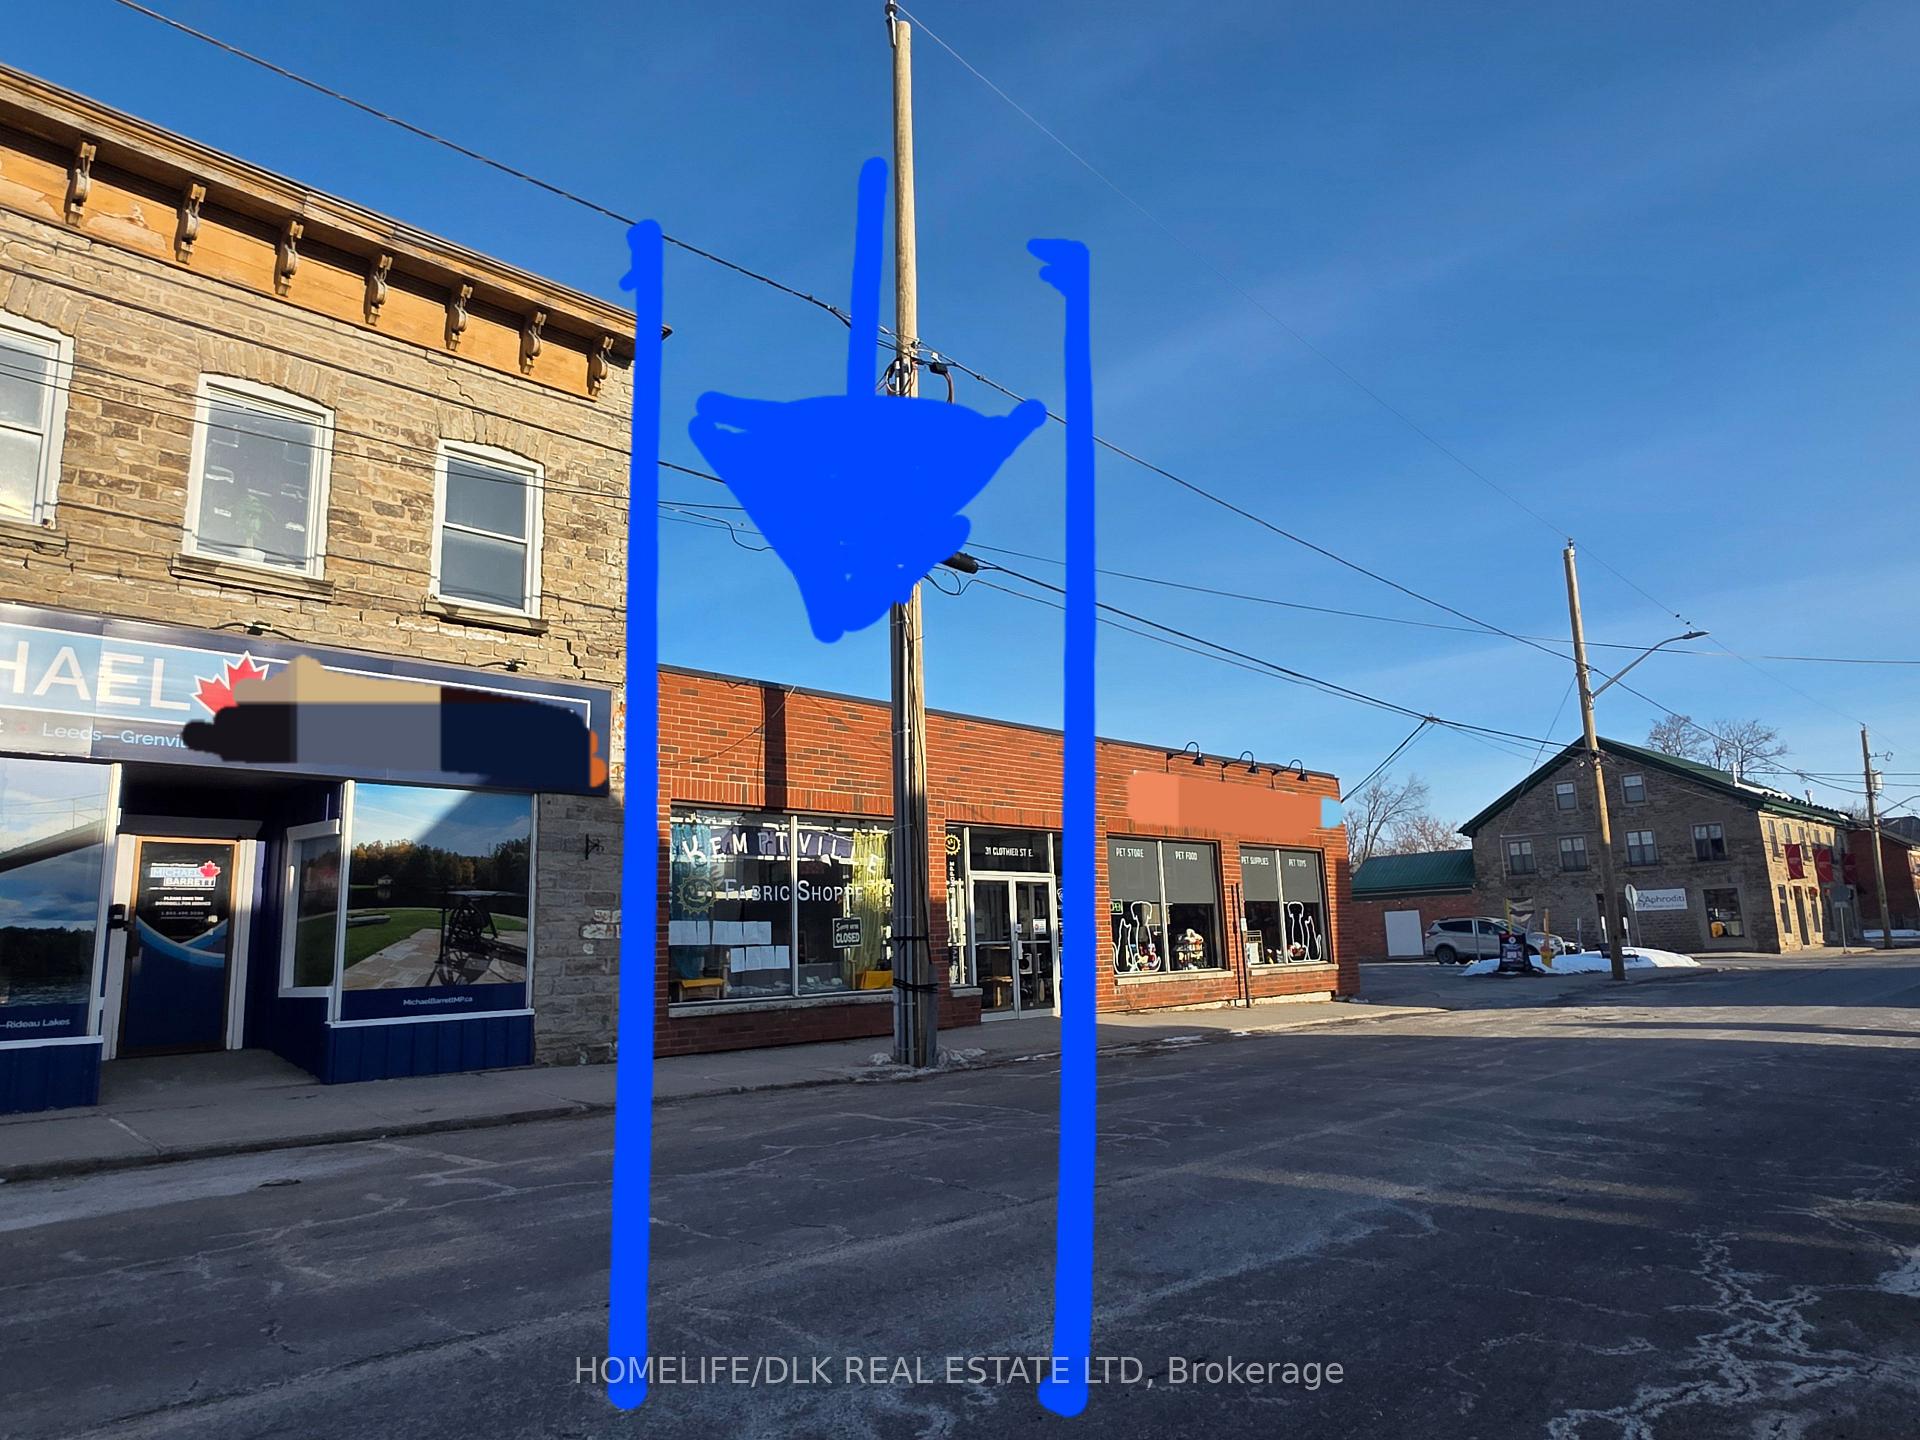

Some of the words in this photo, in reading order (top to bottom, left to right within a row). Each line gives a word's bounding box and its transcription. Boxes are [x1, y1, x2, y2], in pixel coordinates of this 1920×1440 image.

[1020, 848, 1027, 857] ST
[1115, 847, 1126, 857] PET
[1127, 848, 1144, 858] STORE
[1175, 851, 1185, 860] PET
[1186, 851, 1198, 861] FOOD
[1241, 856, 1249, 864] PET
[1288, 858, 1296, 867] PET
[166, 877, 214, 886] BARRETT
[724, 879, 790, 901] FABRIC
[797, 879, 864, 902] SHOPPE
[836, 932, 860, 944] CLOSED
[42, 1018, 71, 1027] Lakes
